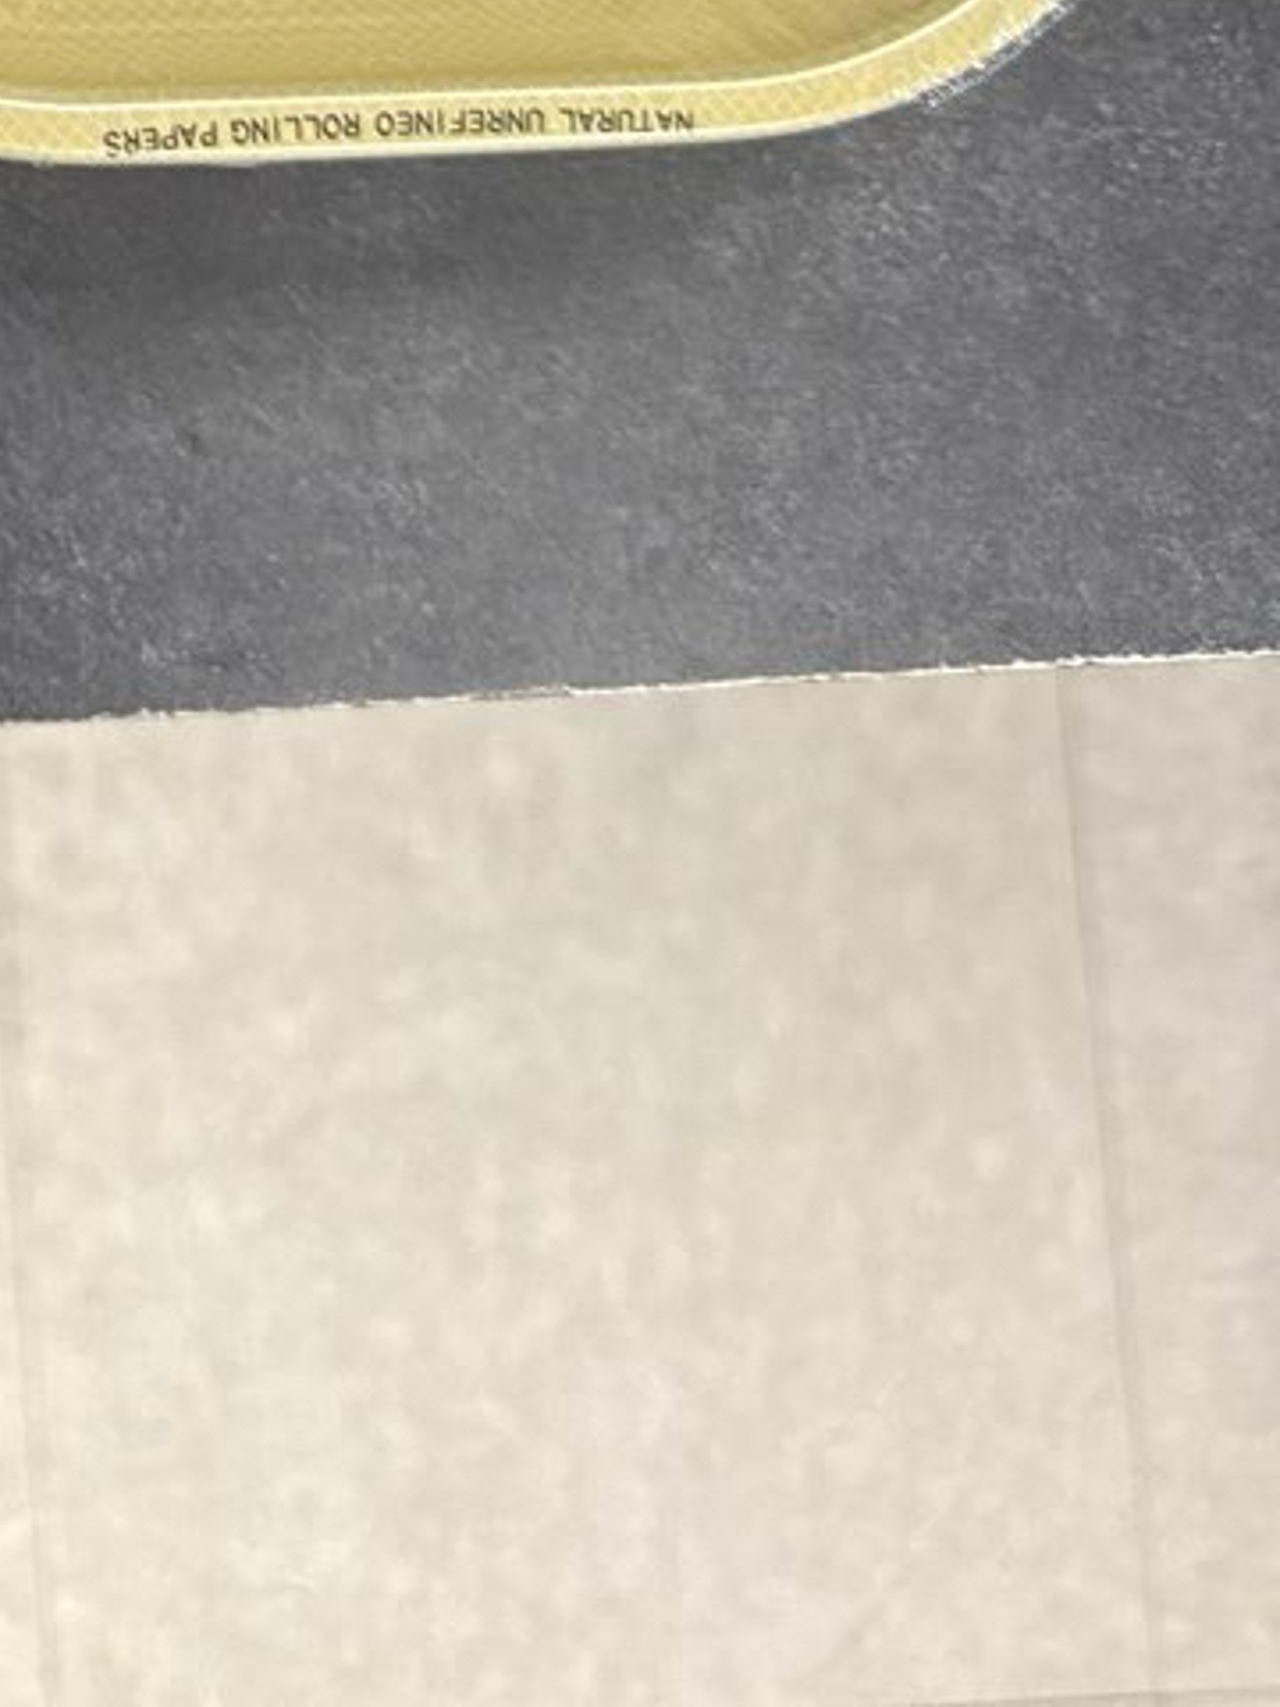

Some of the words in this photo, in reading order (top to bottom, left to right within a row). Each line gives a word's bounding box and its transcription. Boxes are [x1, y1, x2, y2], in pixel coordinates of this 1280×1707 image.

[230, 110, 360, 146] ROLLING
[559, 107, 695, 134] NATURAL
[102, 122, 219, 158] PAPERS
